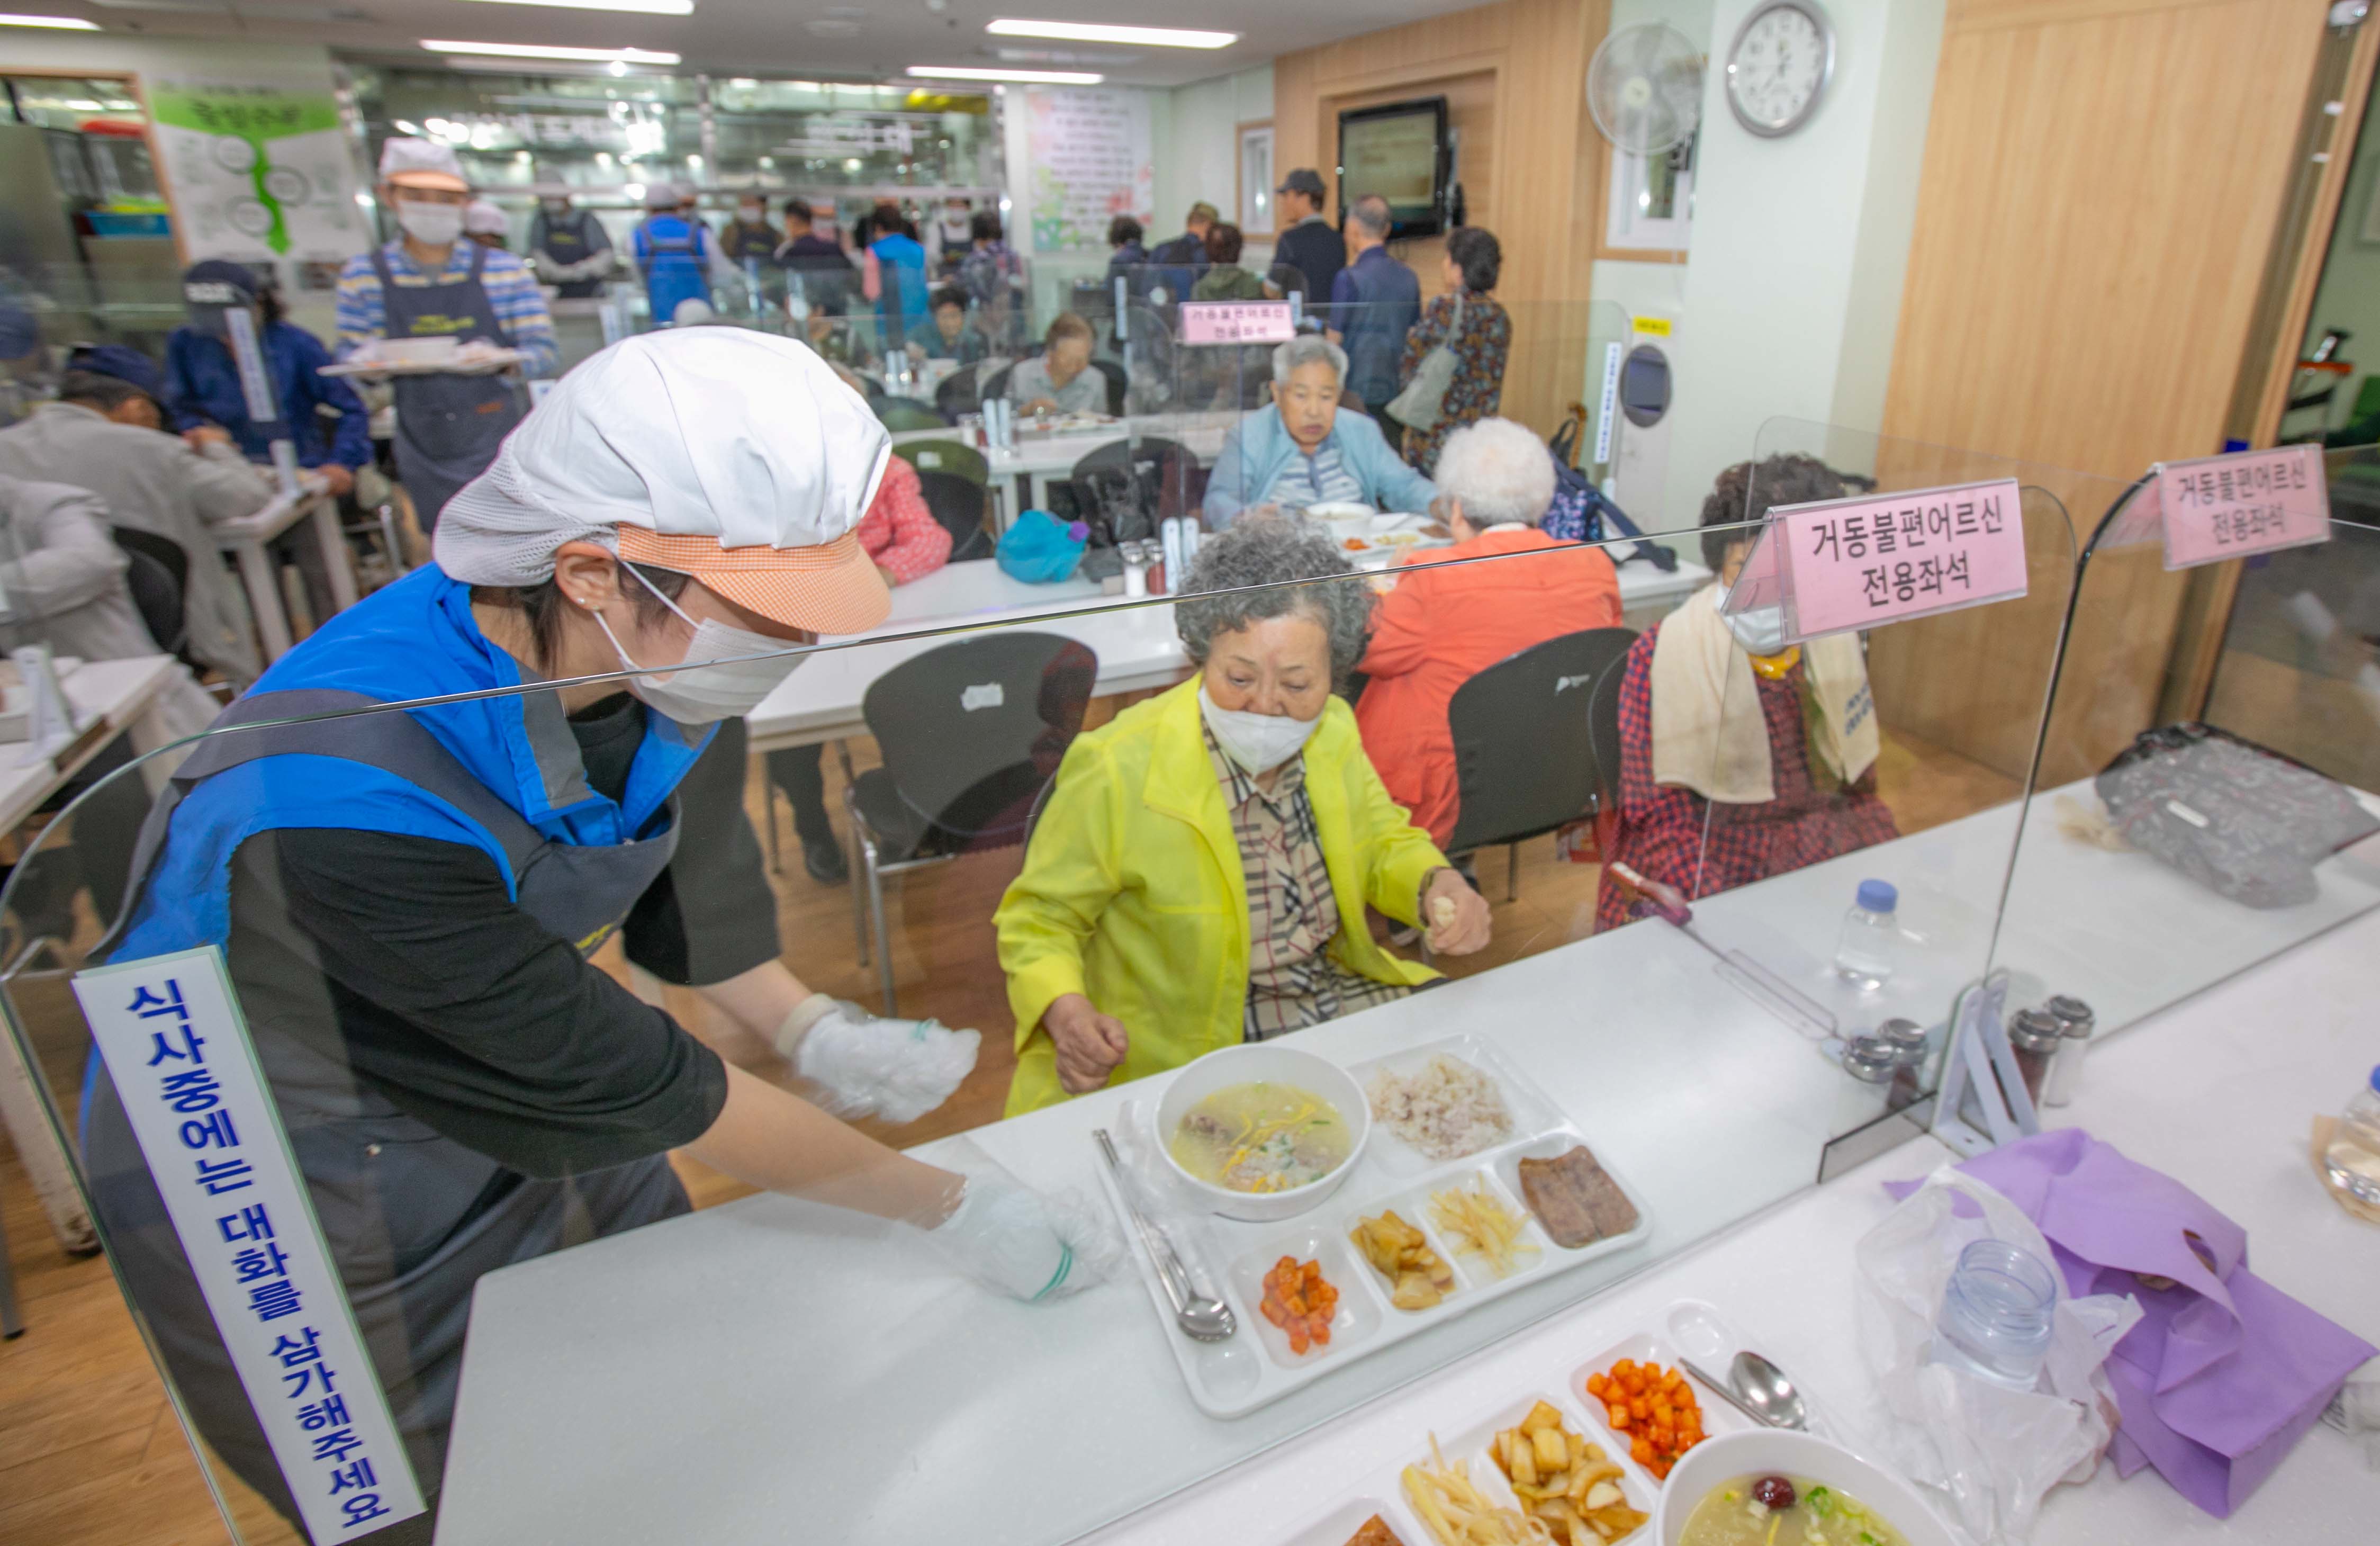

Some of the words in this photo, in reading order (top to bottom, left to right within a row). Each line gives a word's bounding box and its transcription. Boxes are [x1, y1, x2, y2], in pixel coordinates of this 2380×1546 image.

[2178, 459, 2306, 508] 거동불편어르신
[1811, 495, 2003, 562] 거동불편어르신
[2213, 503, 2285, 544] 전용좌석
[1862, 550, 1971, 608] 전용좌석
[127, 978, 253, 1196] 식사중에는
[217, 1202, 303, 1322] 대화를
[270, 1326, 390, 1528] 삼가해주세요
